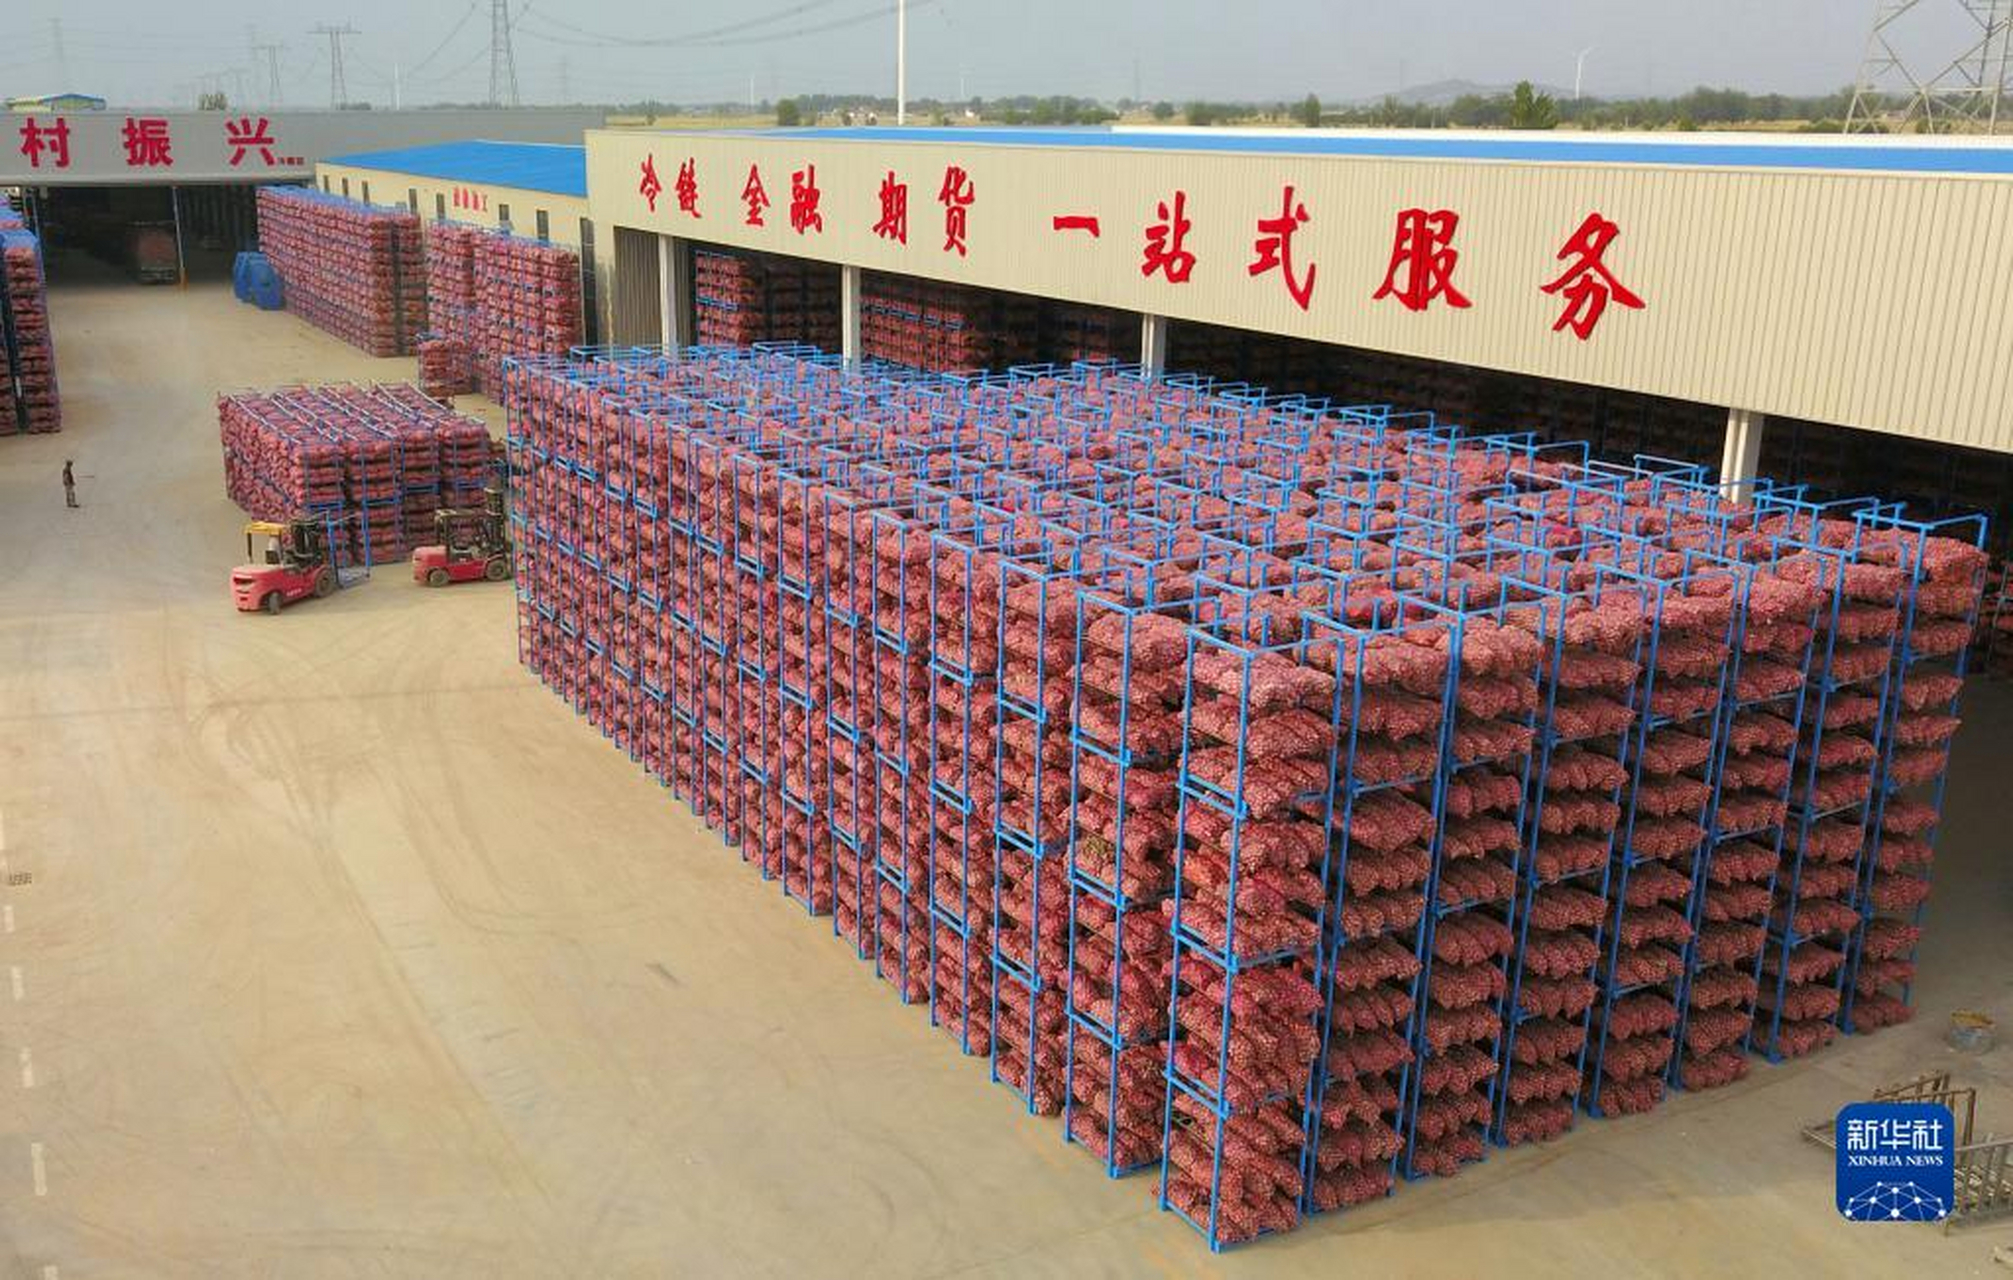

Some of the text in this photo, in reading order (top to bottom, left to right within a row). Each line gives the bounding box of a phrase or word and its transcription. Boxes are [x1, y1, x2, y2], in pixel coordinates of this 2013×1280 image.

[19, 117, 276, 168] 村振兴
[639, 152, 1648, 342] 冷链 金融 期货 一站式服务
